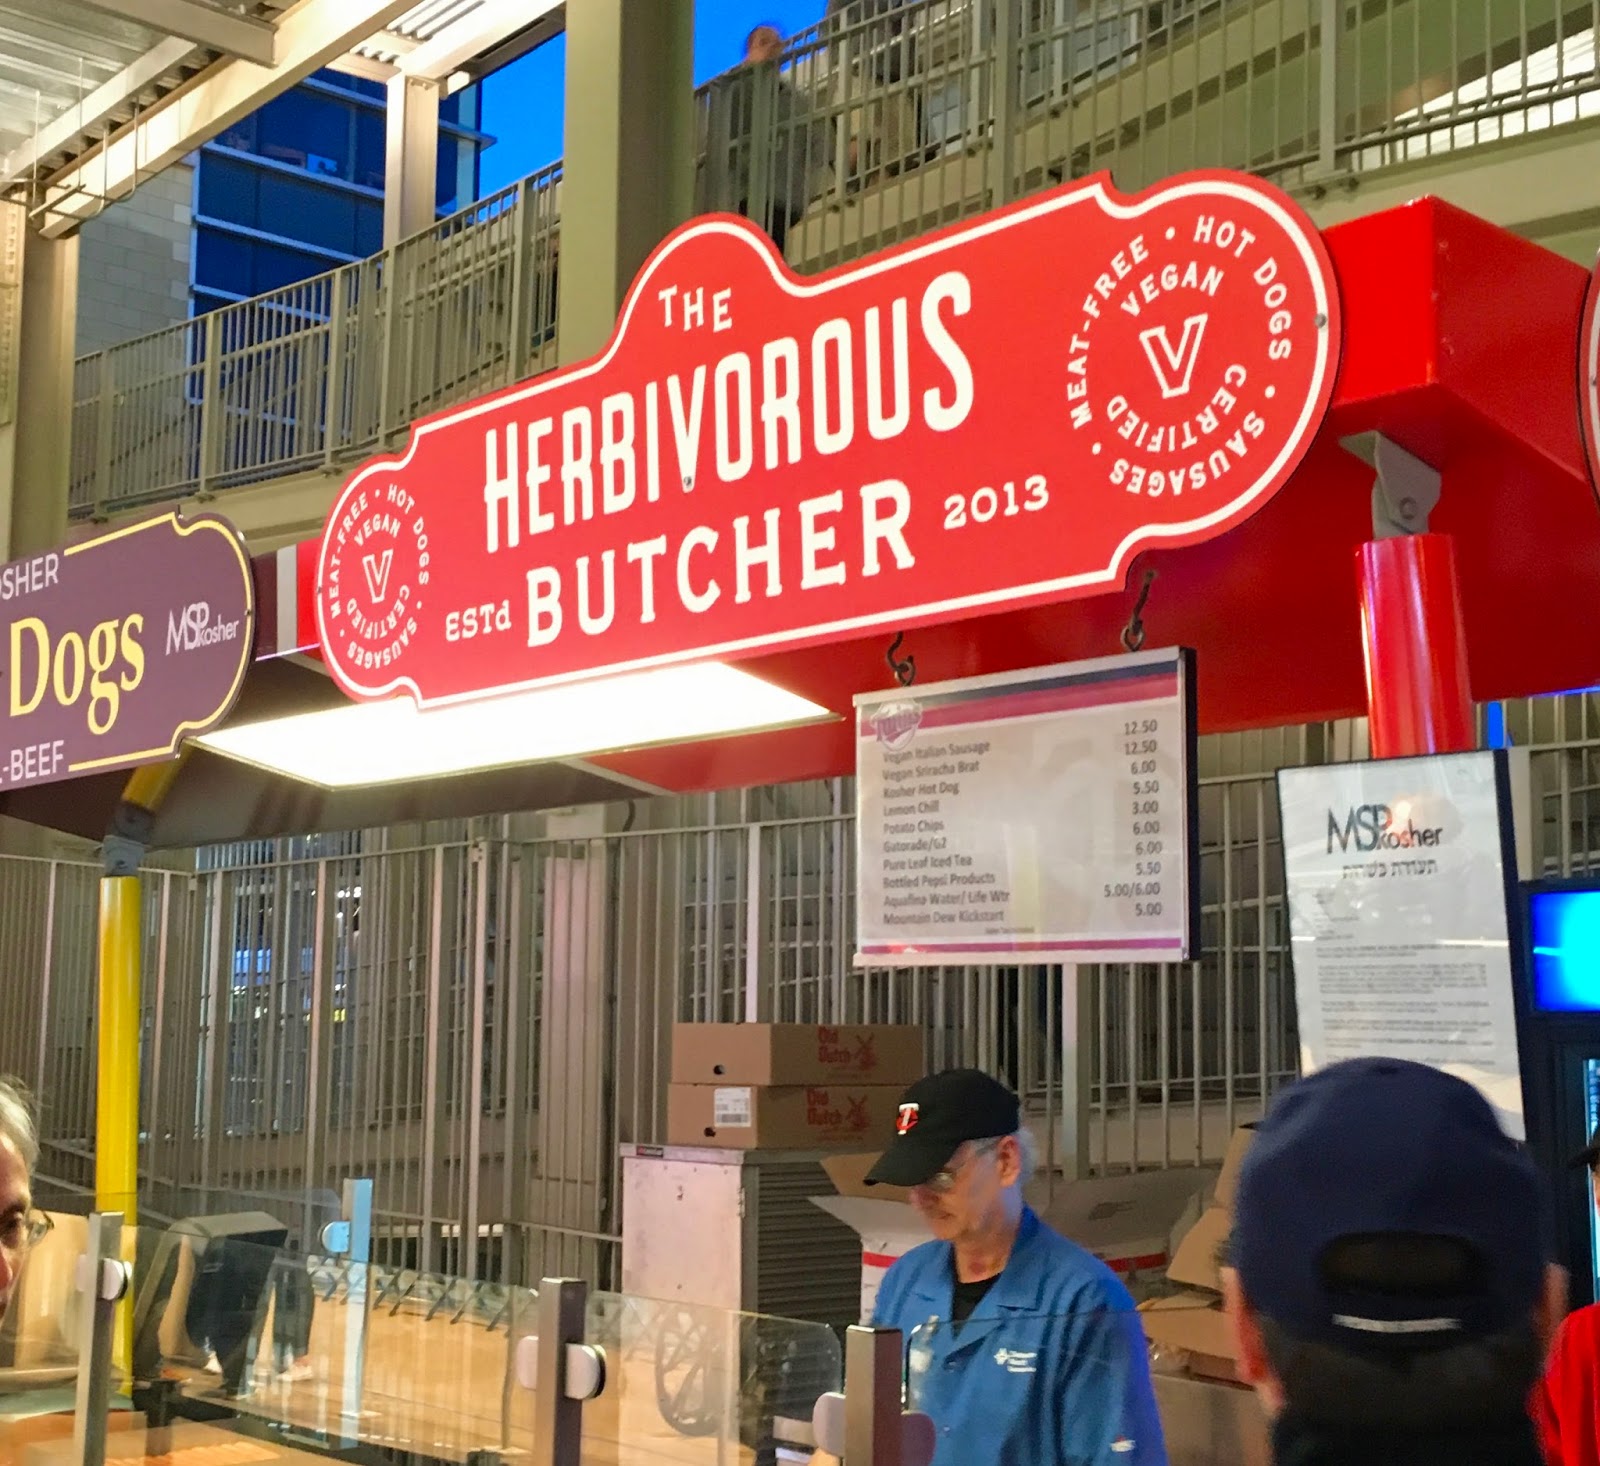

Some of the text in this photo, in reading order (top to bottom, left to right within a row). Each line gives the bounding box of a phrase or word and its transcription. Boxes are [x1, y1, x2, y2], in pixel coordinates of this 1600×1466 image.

[658, 284, 733, 332] THE
[1120, 261, 1224, 317] VEGAN
[1067, 215, 1292, 497] MEAT-FREE HOT DOGS SAUSAGES
[1139, 313, 1208, 399] V
[484, 270, 975, 554] HERBIVOROUS
[1107, 364, 1247, 453] CERTIFIED
[354, 514, 401, 546] VEGAN
[0, 553, 59, 600] SHER
[329, 483, 430, 669] MEAT-FREE HOT DOGS SAUSAGES
[362, 549, 393, 604] V
[526, 479, 915, 648] BUTCHER
[943, 474, 1050, 531] 2013
[347, 585, 409, 640] CERTIFIED
[10, 613, 145, 735] Dogs
[1124, 719, 1157, 736] 12.50
[918, 784, 936, 795] Hot
[939, 782, 960, 796] Dog
[1131, 759, 1156, 775] 6.00
[958, 760, 980, 773] Brat
[1125, 739, 1157, 756] 12.50
[1133, 780, 1159, 795] 5.50
[917, 820, 944, 833] Chips
[1132, 800, 1159, 815] 3.00
[1133, 821, 1160, 836] 6.00
[883, 841, 1162, 871] Pure Leaf Iced Tea 6.00
[950, 873, 996, 885] Products
[1136, 861, 1161, 876] 5.50
[933, 911, 956, 923] Dew
[1135, 902, 1162, 917] 5.00
